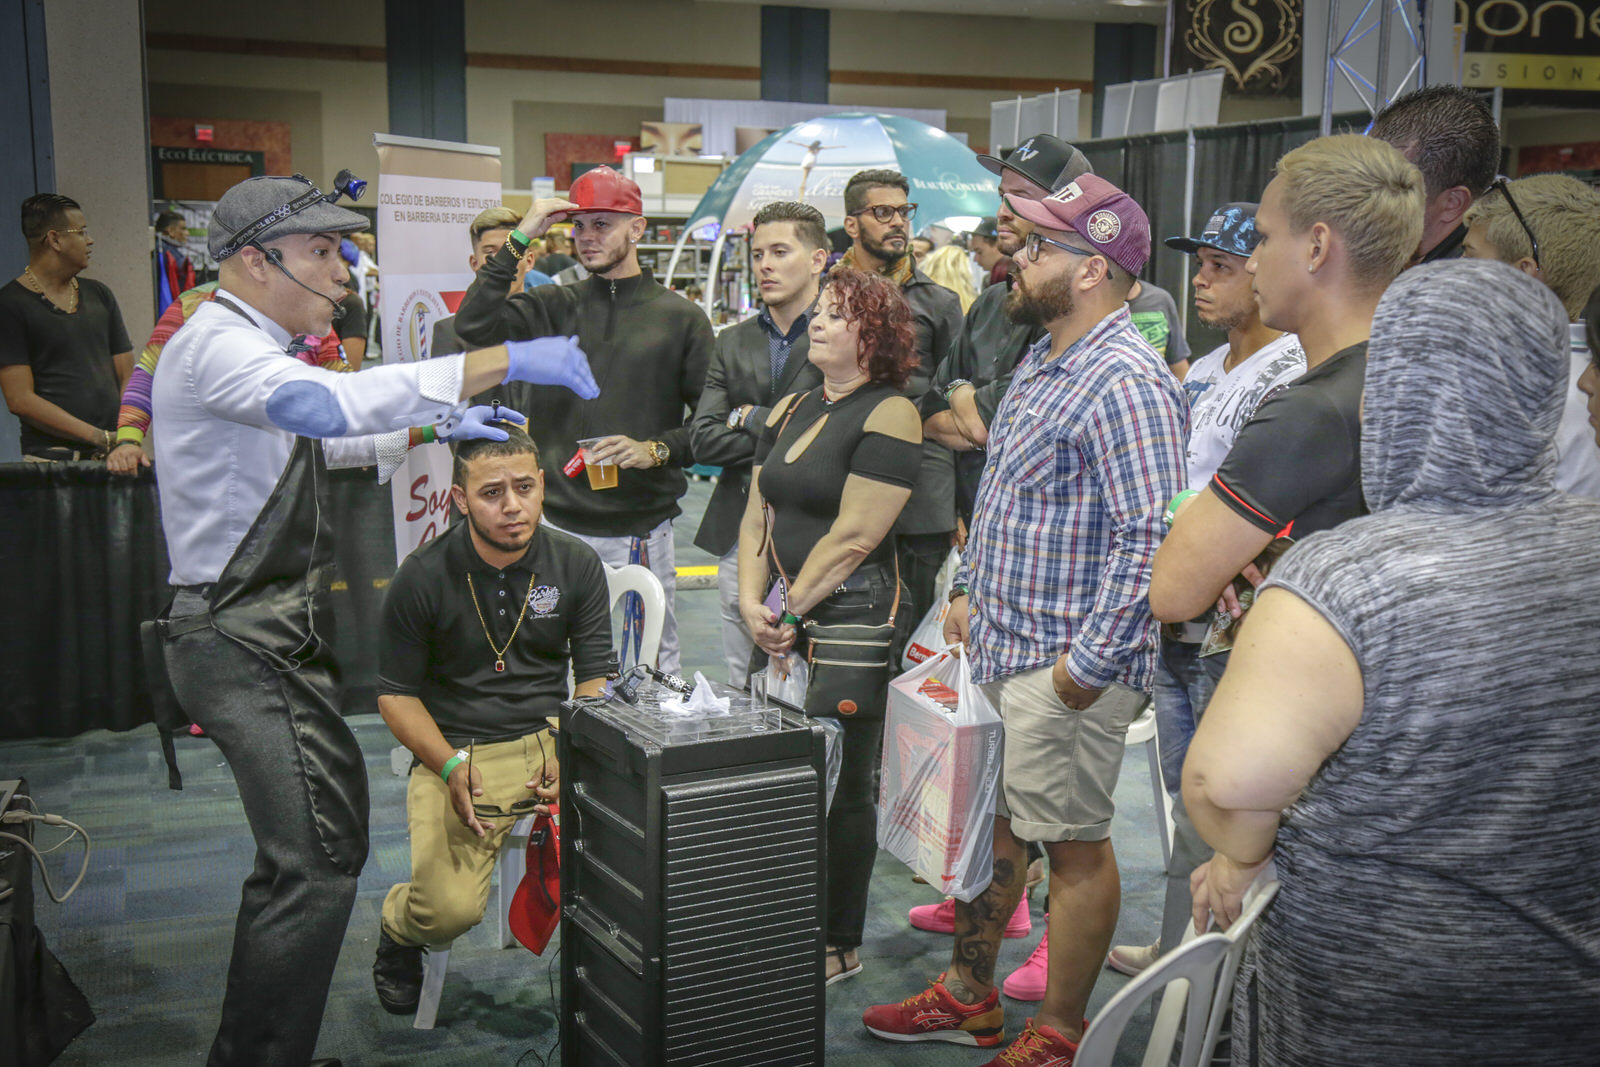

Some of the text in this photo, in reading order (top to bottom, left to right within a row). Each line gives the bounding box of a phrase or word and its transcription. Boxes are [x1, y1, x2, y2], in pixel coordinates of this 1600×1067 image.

[1470, 62, 1600, 81] SSION
[380, 193, 413, 206] COLEGIO
[414, 195, 423, 206] DE
[425, 195, 460, 208] BARBEROS
[462, 197, 466, 208] Y
[394, 210, 406, 222] EN
[407, 211, 440, 223] BARBERIA
[442, 212, 450, 223] DE
[405, 474, 452, 526] Soy
[909, 646, 930, 661] Bern
[986, 729, 997, 765] TURBO
